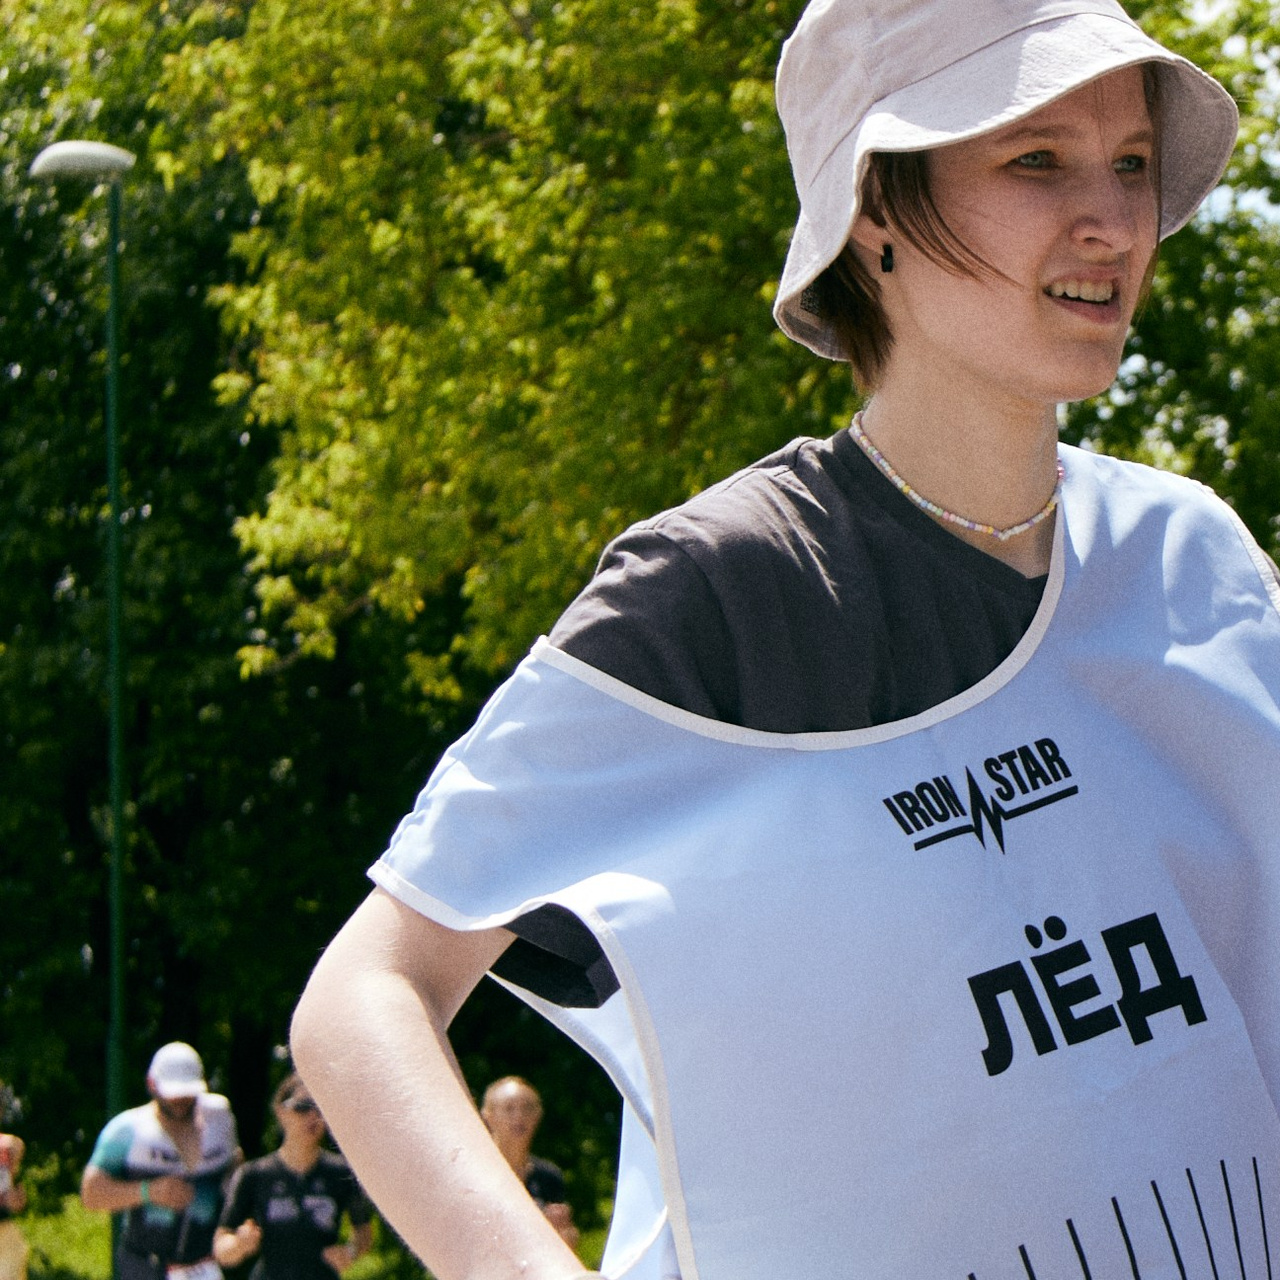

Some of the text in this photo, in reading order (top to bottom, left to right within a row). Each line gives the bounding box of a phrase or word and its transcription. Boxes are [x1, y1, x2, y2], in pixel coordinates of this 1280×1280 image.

[883, 737, 1073, 836] IRON STAR
[967, 912, 1208, 1077] ЛЁД
